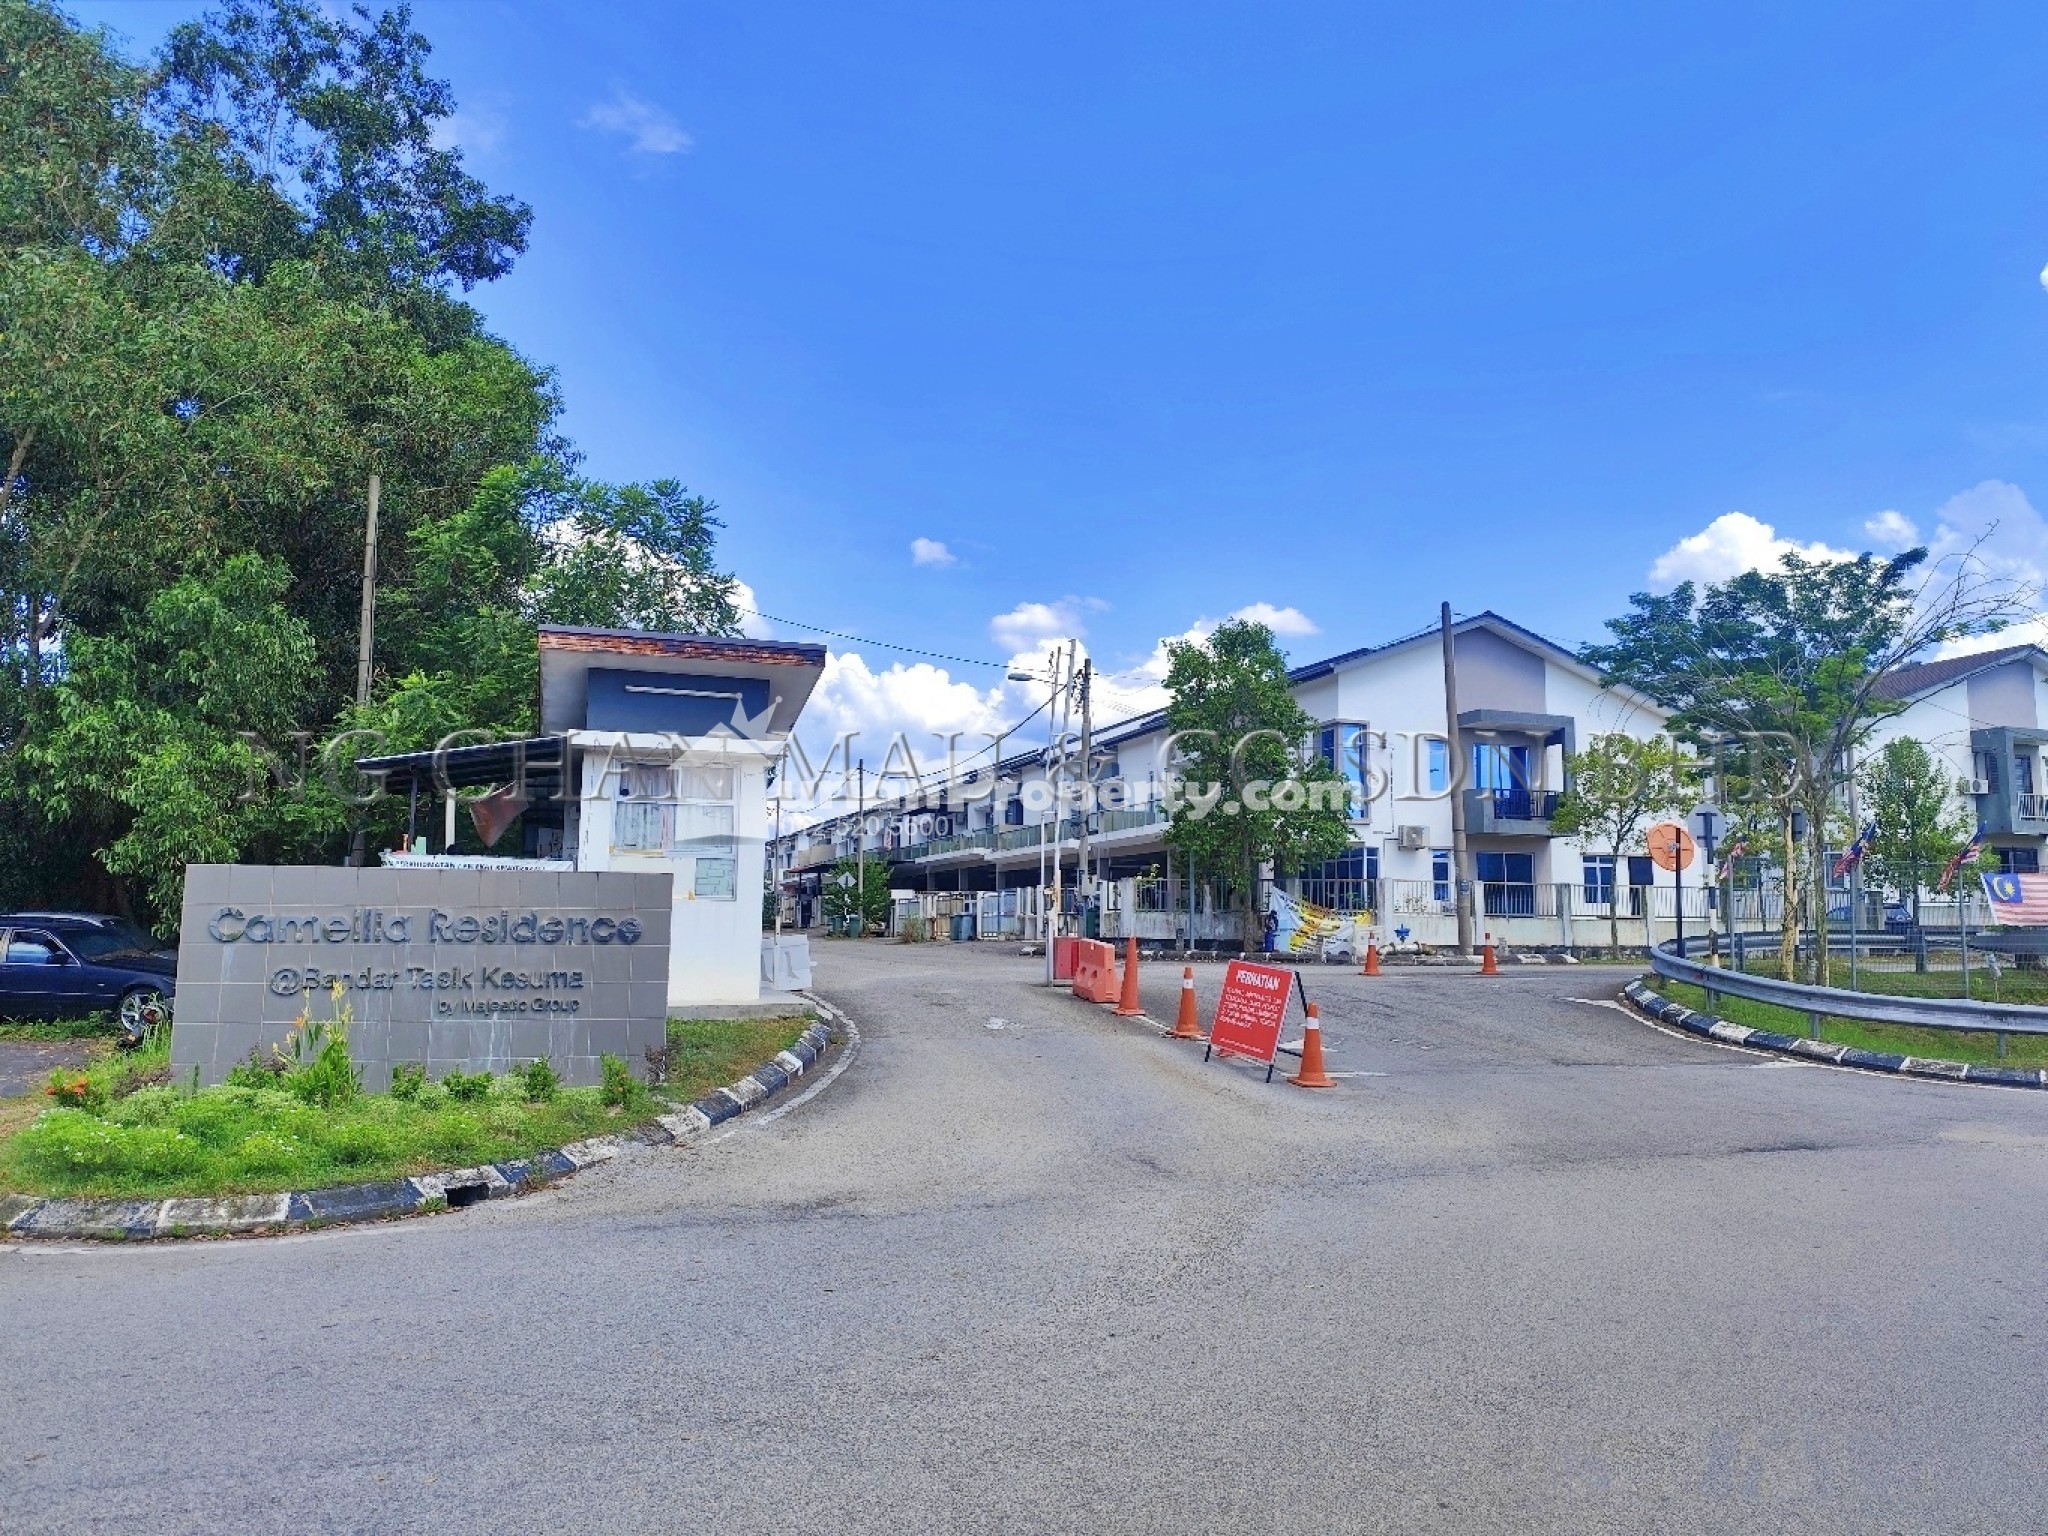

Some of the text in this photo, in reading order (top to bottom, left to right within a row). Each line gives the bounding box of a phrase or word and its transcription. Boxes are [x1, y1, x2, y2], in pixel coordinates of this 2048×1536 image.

[208, 905, 643, 945] Camellia Residence
[406, 966, 474, 990] Tasik
[482, 966, 584, 990] Kesuma
[438, 999, 458, 1016] by
[530, 997, 581, 1015] Group
